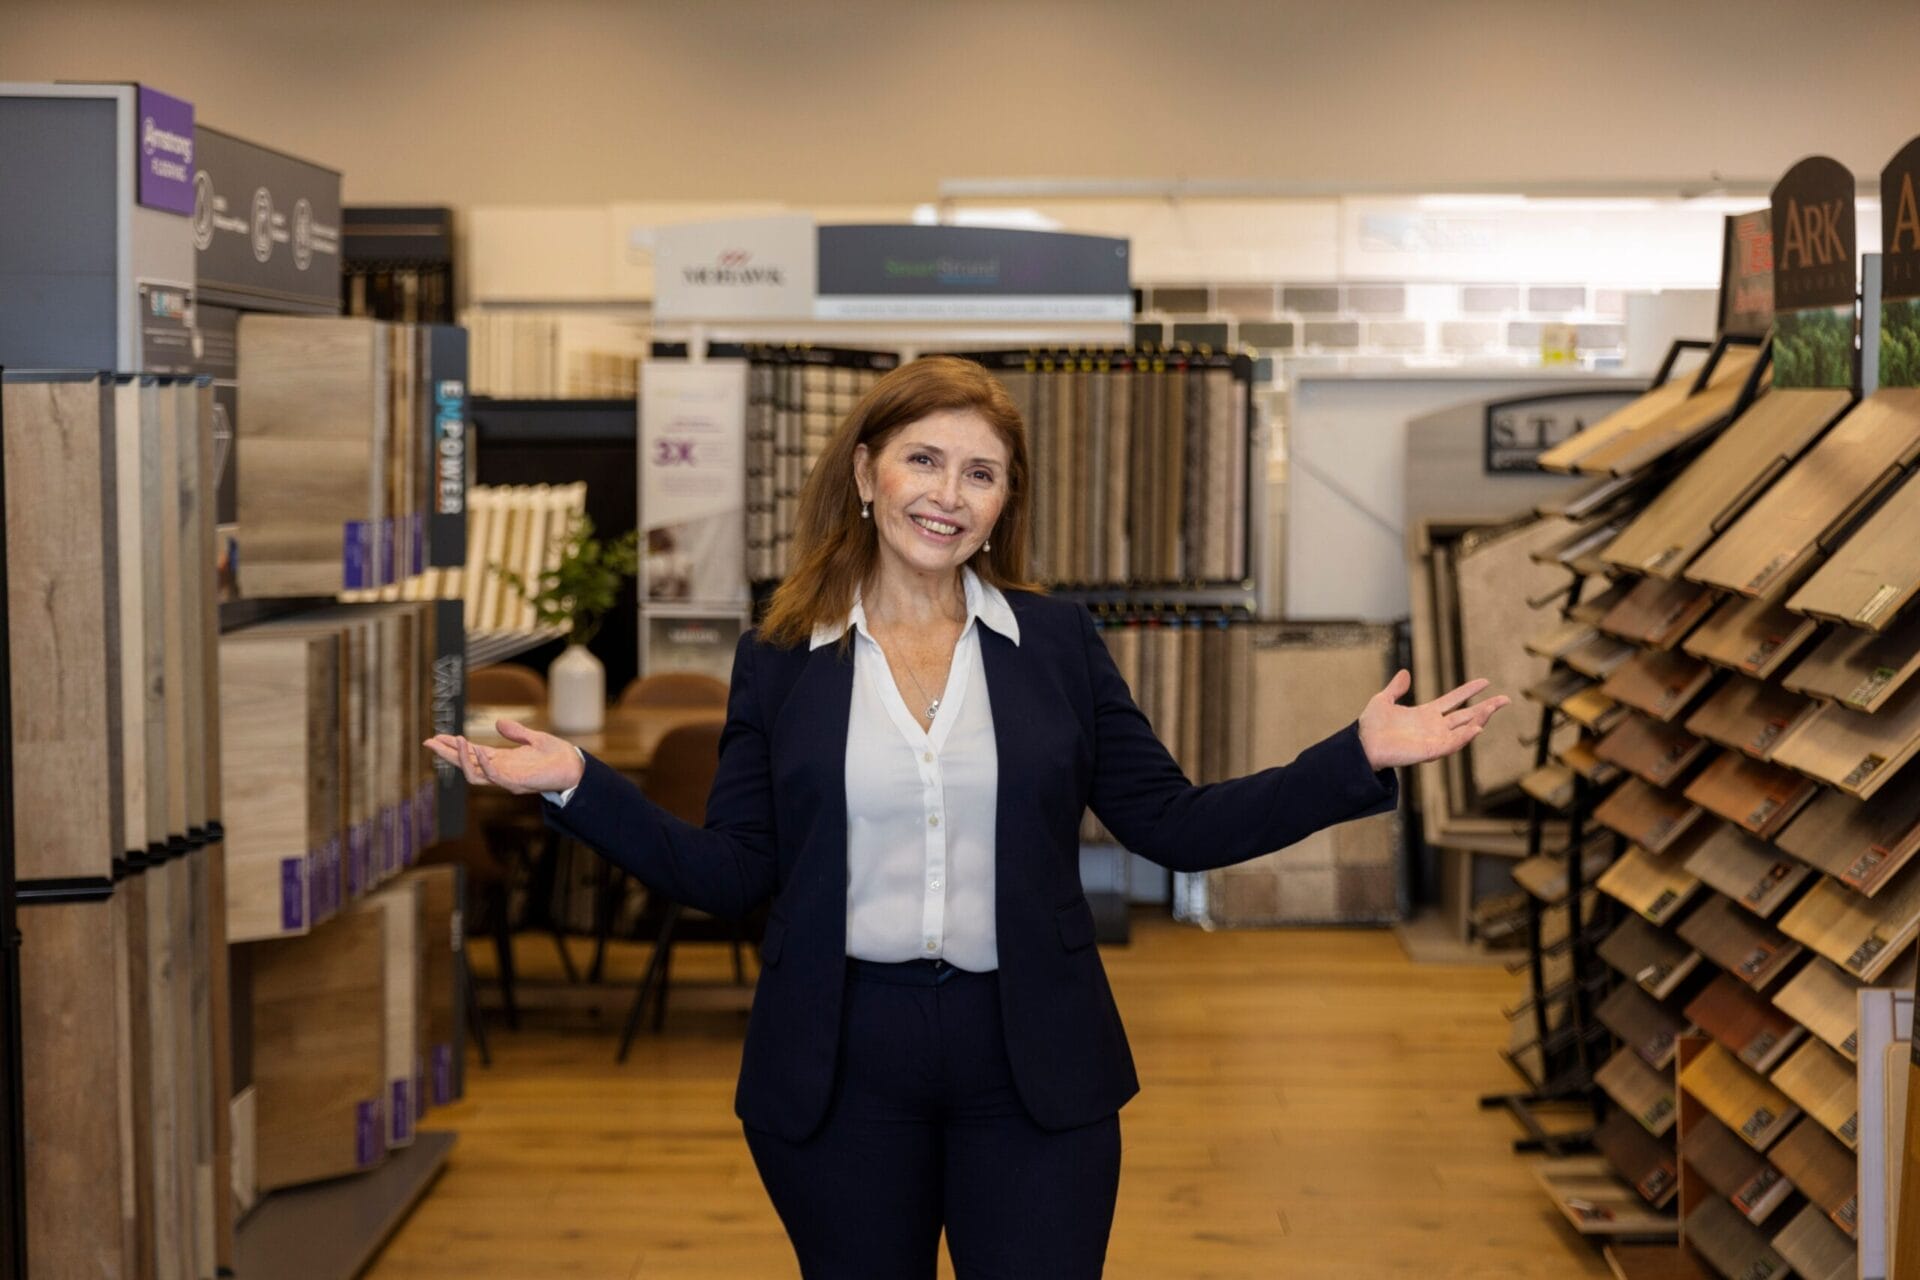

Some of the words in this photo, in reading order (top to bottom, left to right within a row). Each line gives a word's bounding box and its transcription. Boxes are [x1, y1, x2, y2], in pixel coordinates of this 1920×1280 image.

[143, 117, 193, 164] Armstrong
[1780, 196, 1848, 272] ARK
[1891, 171, 1920, 254] A
[435, 379, 464, 515] EMPOWER
